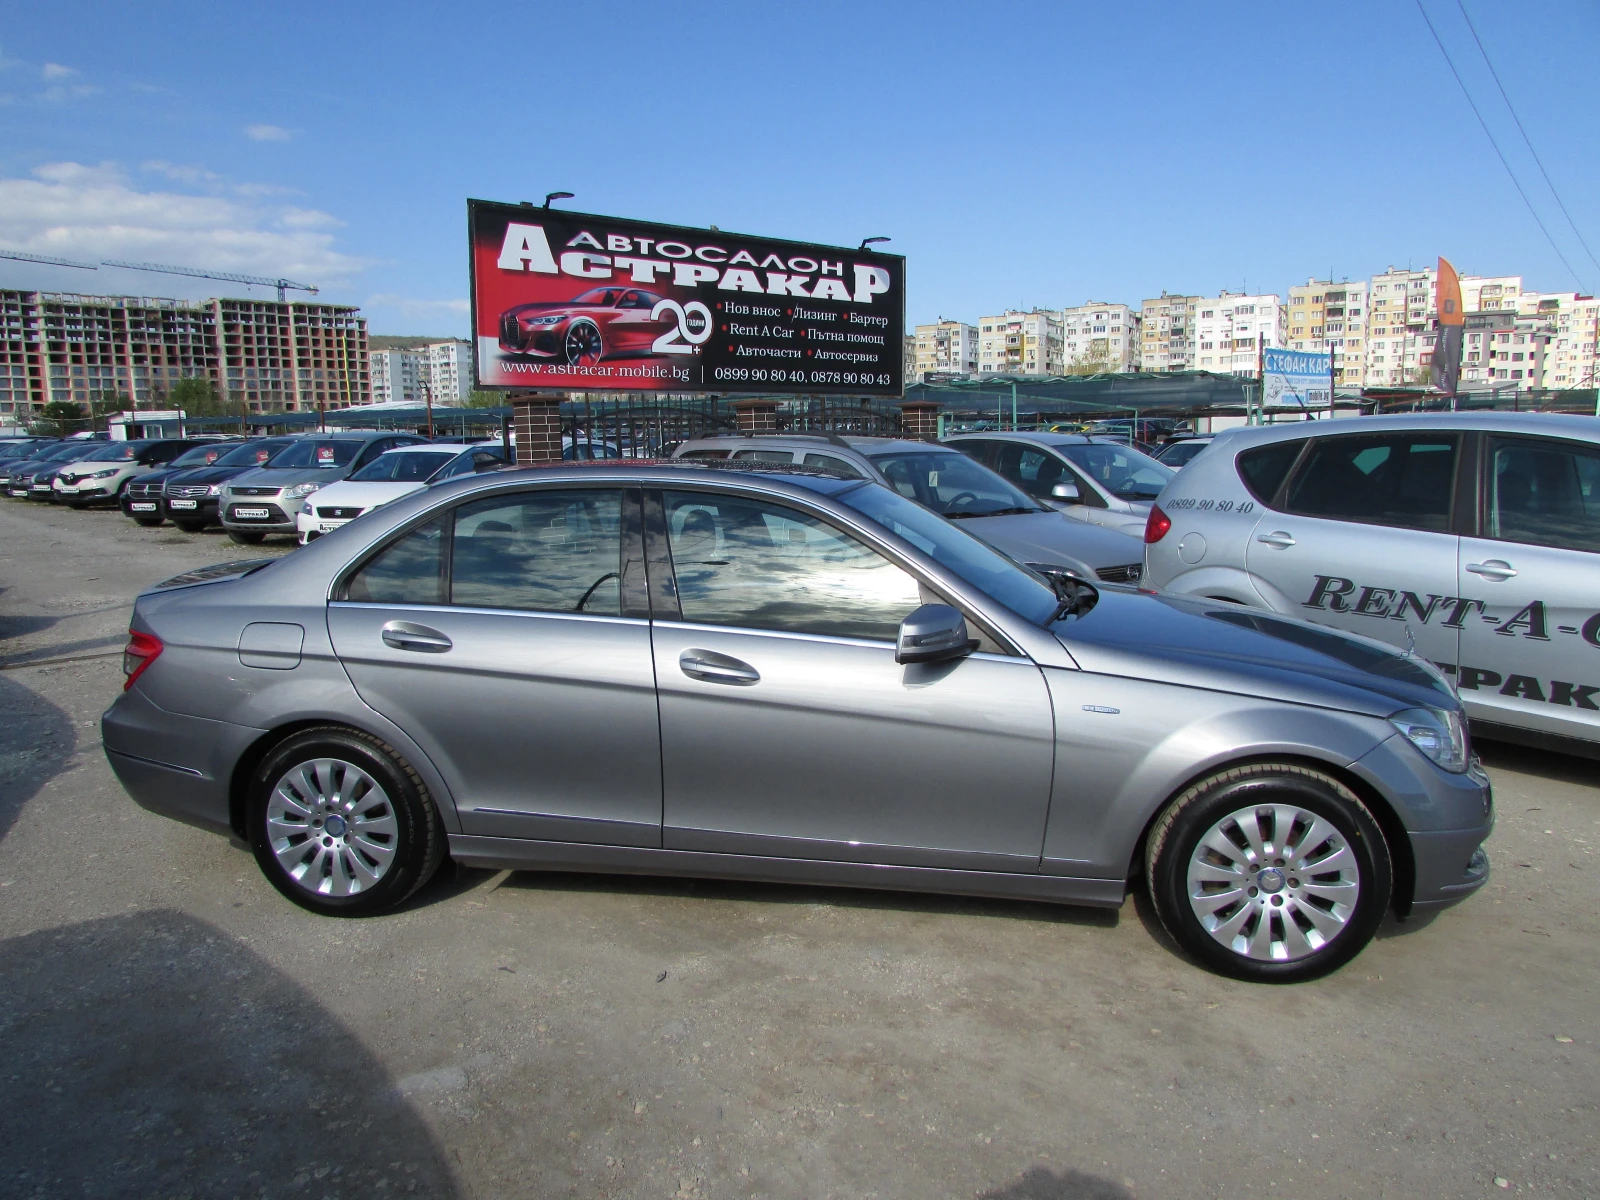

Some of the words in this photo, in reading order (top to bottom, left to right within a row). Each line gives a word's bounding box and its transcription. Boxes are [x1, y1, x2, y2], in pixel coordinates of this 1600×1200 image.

[566, 231, 843, 276] АВТОСАЛОН
[497, 222, 890, 304] АСТРАКАР
[725, 301, 750, 315] Нов
[752, 306, 781, 317] внос
[794, 307, 838, 322] Лизинг
[850, 312, 888, 328] Бартер
[729, 323, 759, 336] Rent
[761, 326, 771, 337] A
[773, 326, 795, 338] Car
[808, 329, 845, 342] Пътна
[847, 334, 885, 346] помощ
[736, 345, 801, 358] Авточасти
[814, 349, 879, 363] Автосервиз
[501, 361, 690, 381] www.astracar.mobile.bg
[1265, 353, 1307, 373] СТЕФАН
[1308, 357, 1330, 374] КАР
[715, 367, 749, 380] 0899
[751, 369, 768, 381] 90
[770, 369, 787, 382] 80
[789, 370, 808, 383] 40,
[811, 371, 841, 383] 0878
[843, 372, 858, 384] 90
[860, 373, 875, 385] 80
[876, 374, 891, 386] 43
[1166, 498, 1196, 510] 0899
[1196, 499, 1214, 511] 90
[1215, 500, 1234, 512] 80
[1235, 501, 1254, 514] 40
